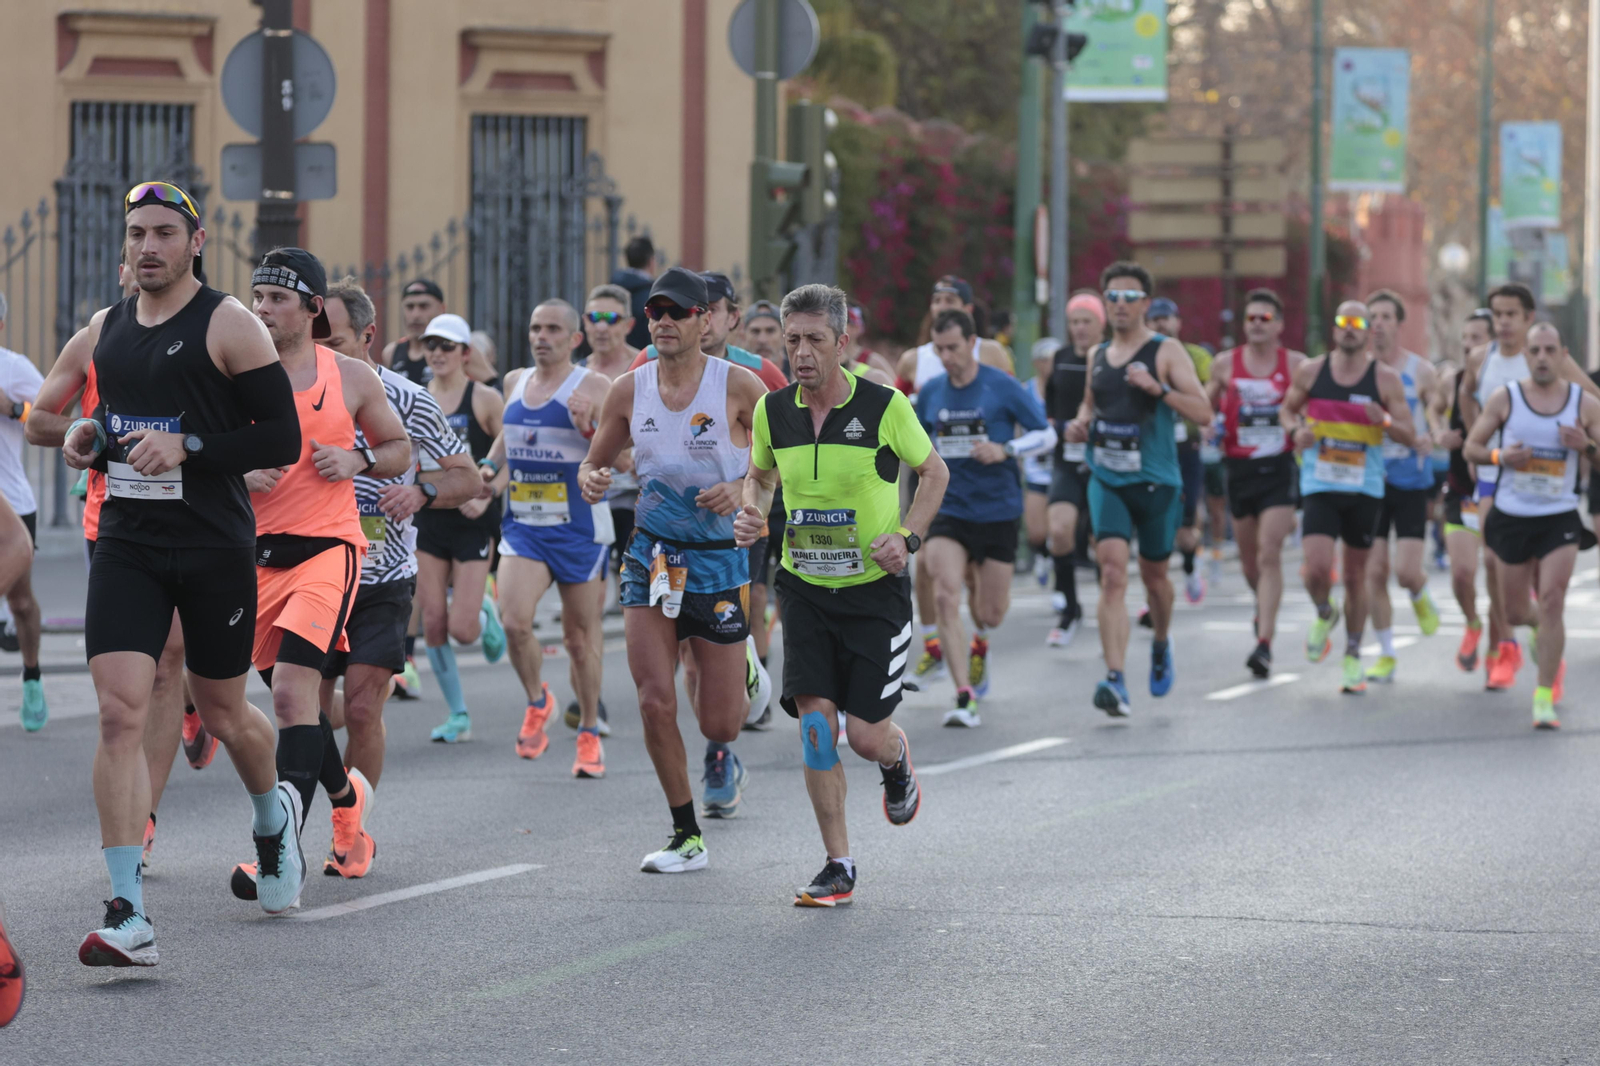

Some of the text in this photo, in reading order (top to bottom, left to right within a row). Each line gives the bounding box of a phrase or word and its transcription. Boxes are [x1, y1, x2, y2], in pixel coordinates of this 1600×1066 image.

[123, 420, 169, 432] ZURICH
[523, 472, 558, 482] ZURICH
[806, 512, 847, 523] ZURICH
[809, 534, 833, 546] 1330
[792, 551, 858, 560] MANEL OLIVEIRA
